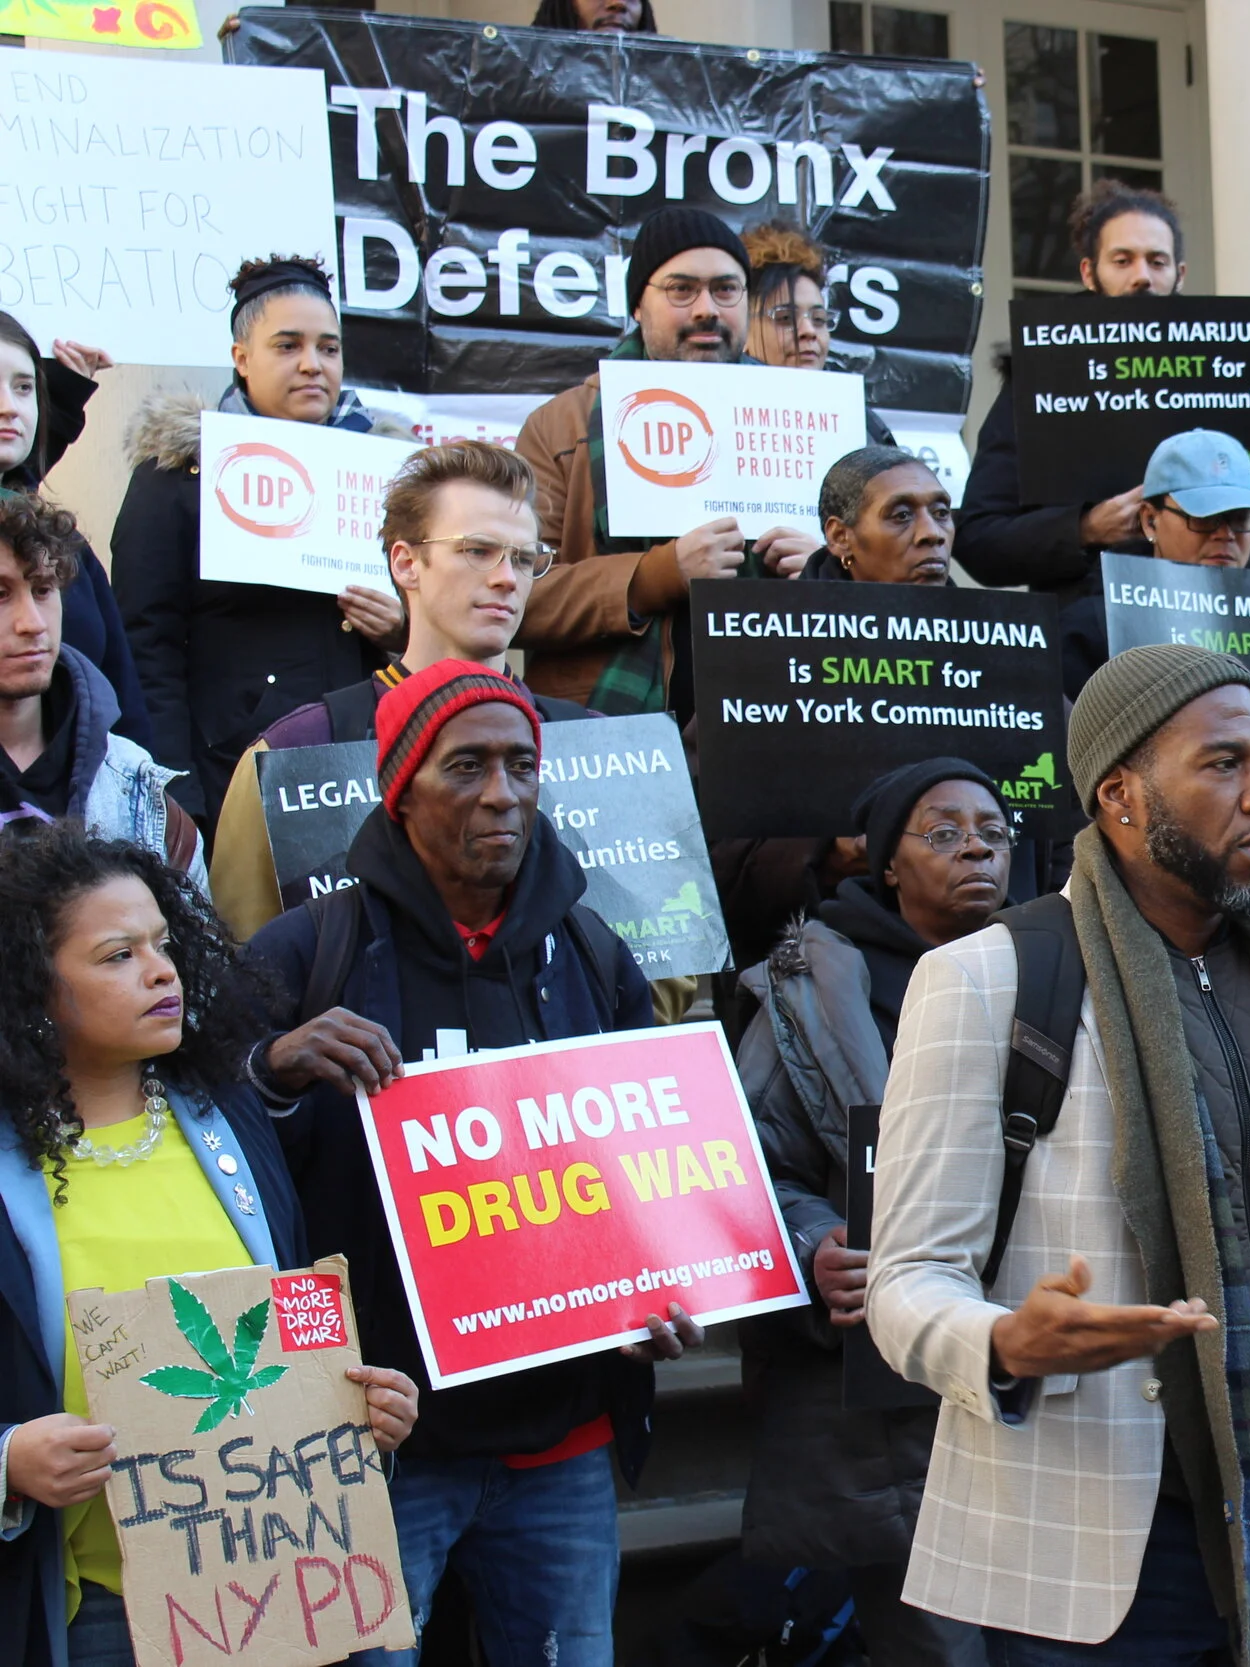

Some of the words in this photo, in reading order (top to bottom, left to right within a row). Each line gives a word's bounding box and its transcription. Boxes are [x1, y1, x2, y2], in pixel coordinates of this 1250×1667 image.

[10, 70, 88, 104] END
[0, 113, 305, 163] MINALIZATION
[331, 85, 537, 191] The
[586, 104, 896, 212] Bronx
[138, 189, 223, 234] FOR
[0, 242, 236, 314] BERATIO
[1022, 322, 1162, 347] LEGALIZING
[1088, 359, 1108, 380] is
[1115, 355, 1206, 380] SMART
[1212, 355, 1246, 378] for
[1035, 393, 1089, 413] New
[1094, 388, 1150, 411] York
[733, 406, 839, 433] IMMIGRANT
[643, 421, 694, 456] IDP
[735, 432, 816, 456] DEFENSE
[737, 456, 815, 480] PROJECT
[242, 472, 294, 510] IDP
[337, 493, 382, 518] DEFE
[704, 500, 744, 513] FIGHTING
[747, 502, 762, 513] FOR
[764, 502, 797, 515] JUSTICE
[301, 553, 343, 570] FIGHTING
[345, 561, 361, 572] FOR
[363, 563, 391, 576] JUSTI
[1109, 582, 1228, 615] LEGALIZING
[707, 612, 879, 640] LEGALIZING
[887, 616, 1047, 649] MARIJUANA
[1171, 627, 1187, 645] is
[788, 658, 812, 684] is
[821, 656, 934, 686] SMART
[941, 661, 982, 689] for
[722, 698, 788, 724] New
[795, 697, 864, 724] York
[871, 699, 1044, 731] Communities
[278, 778, 382, 813] LEGAL
[538, 748, 672, 784] RIJUANA
[996, 780, 1043, 800] ART
[552, 803, 600, 831] for
[576, 836, 681, 870] unities
[608, 914, 691, 940] MART
[633, 949, 673, 966] ORK
[401, 1106, 502, 1174] NO
[516, 1075, 690, 1150] MORE
[419, 1161, 611, 1248] DRUG
[618, 1139, 747, 1203] WAR
[283, 1288, 335, 1311] MORE
[290, 1278, 316, 1295] NO
[452, 1248, 775, 1335] www.nomoredrugwar.org
[73, 1306, 111, 1336] WE
[280, 1308, 340, 1330] DRUG
[291, 1319, 341, 1347] WAR!
[96, 1342, 147, 1380] WAIT!
[111, 1449, 208, 1528] IS
[218, 1421, 384, 1502] SAFER
[170, 1492, 353, 1576] THAN
[165, 1553, 395, 1667] NYPD
